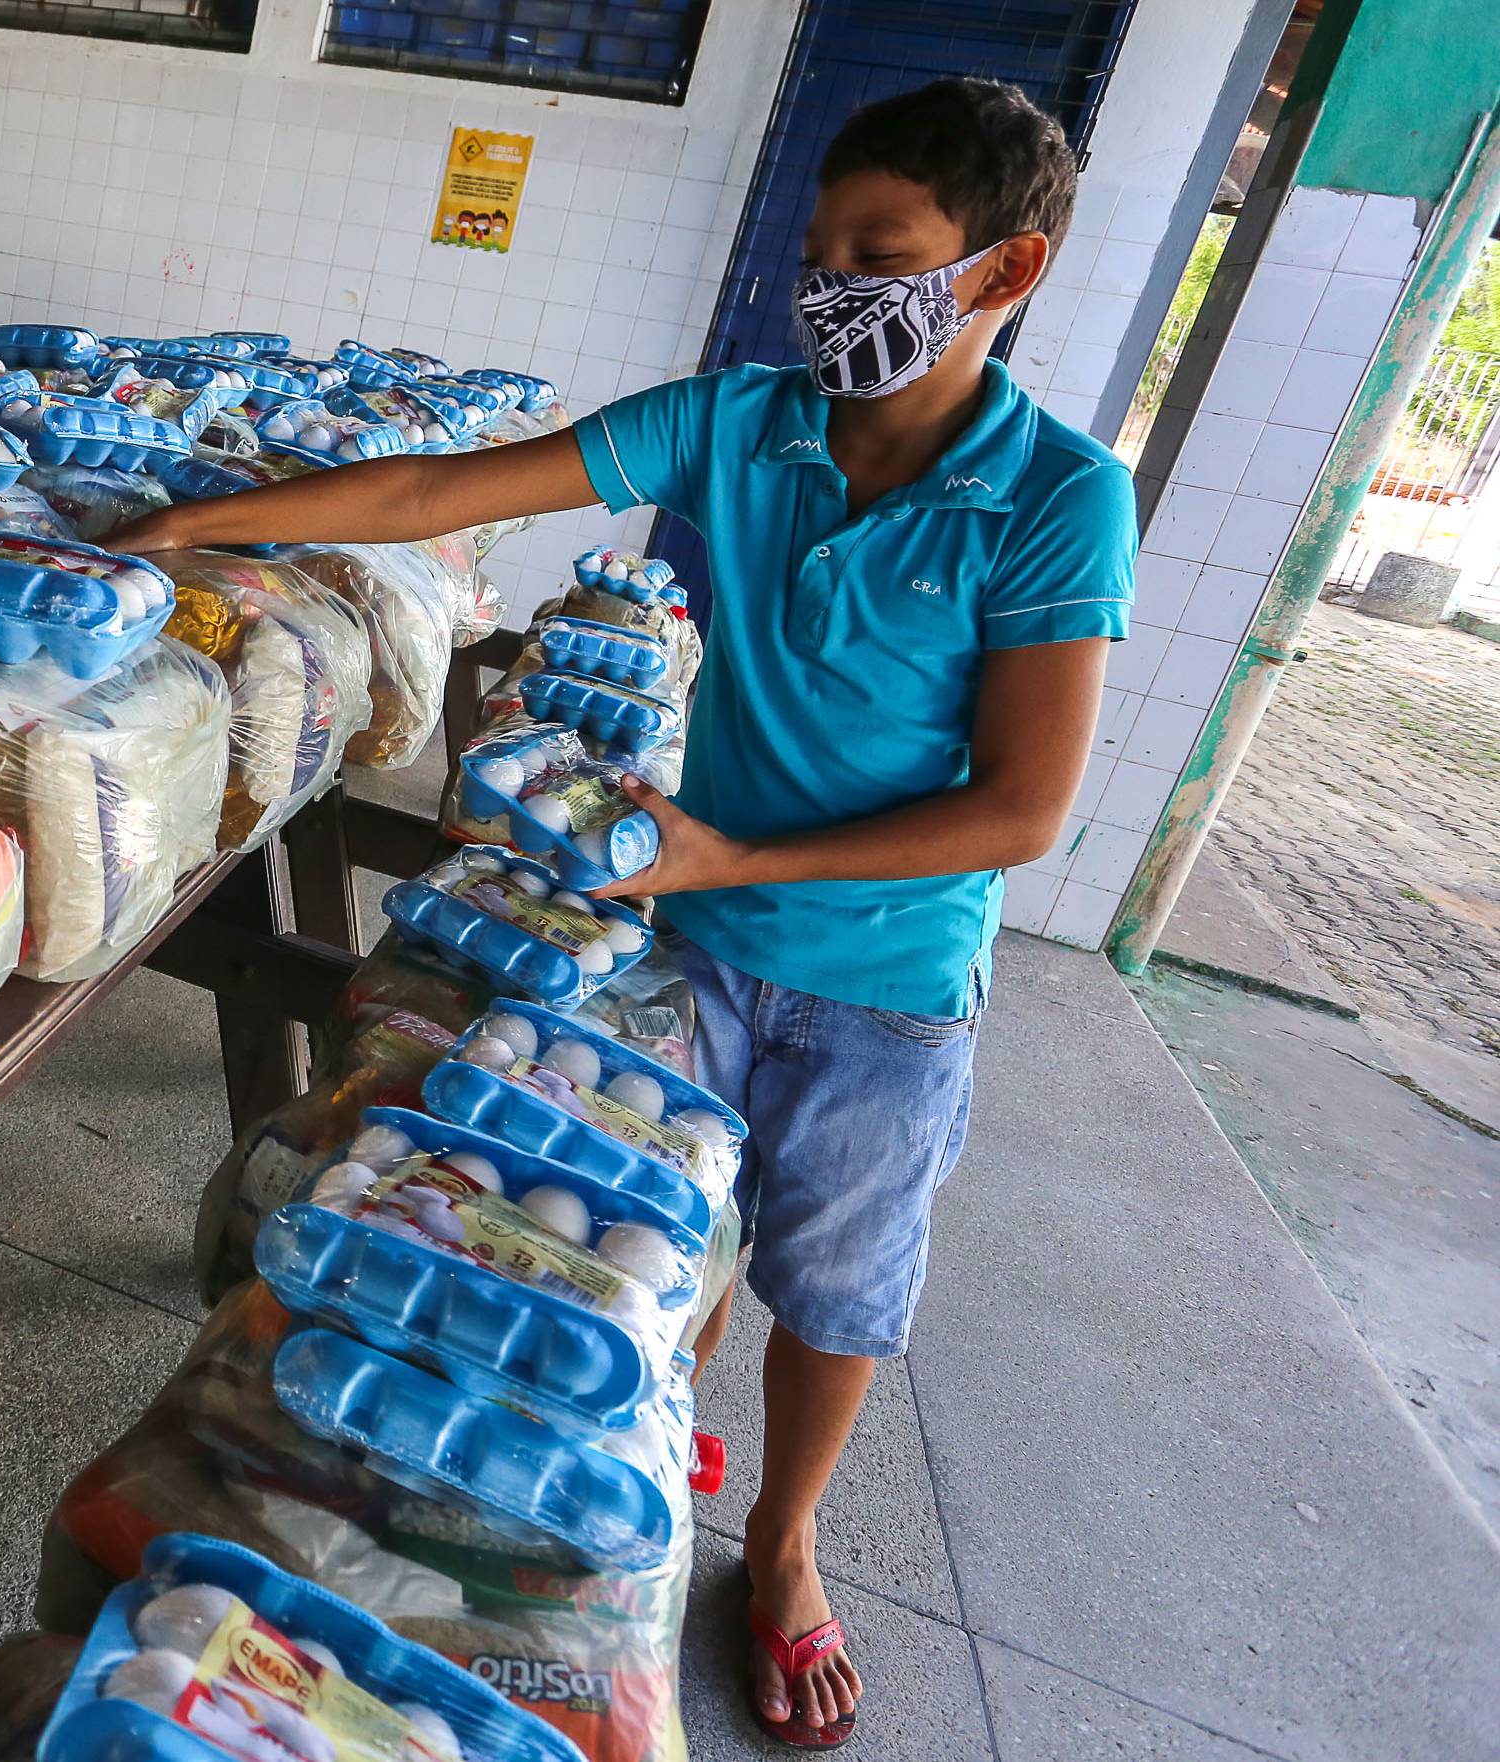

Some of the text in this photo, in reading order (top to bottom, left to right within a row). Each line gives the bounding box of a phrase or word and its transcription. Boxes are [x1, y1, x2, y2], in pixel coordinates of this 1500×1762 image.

[817, 293, 901, 364] CEARÁ
[512, 1252, 534, 1270] 12
[239, 1637, 312, 1704] EMAPE
